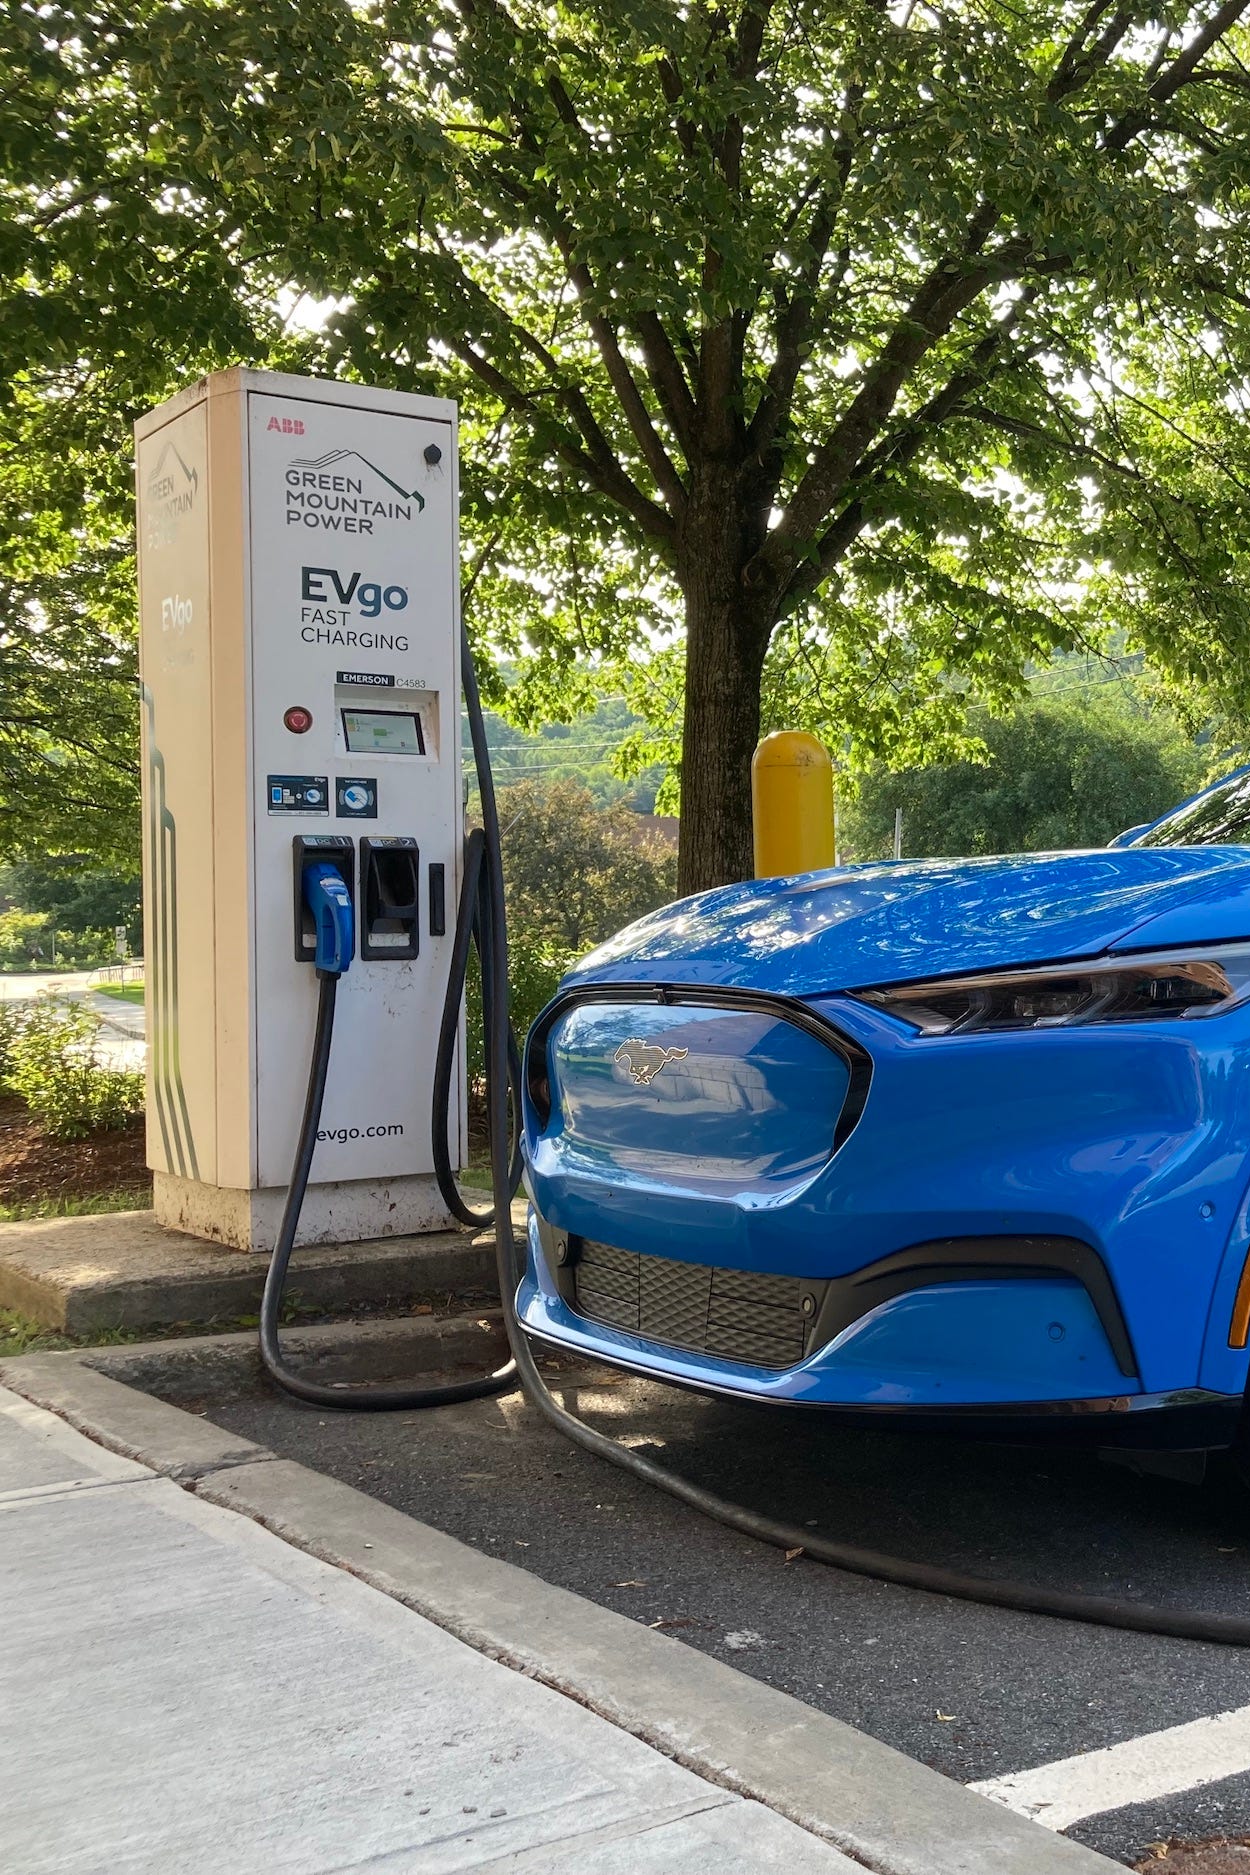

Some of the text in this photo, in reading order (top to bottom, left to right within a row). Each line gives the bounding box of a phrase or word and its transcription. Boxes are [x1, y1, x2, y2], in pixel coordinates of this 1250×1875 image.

[267, 416, 305, 435] ABB
[285, 469, 362, 494] GREEN
[286, 490, 411, 520] MOUNTAIN
[286, 510, 373, 535] POWER
[302, 566, 408, 617] EVgo
[161, 594, 193, 638] EVgo
[301, 607, 351, 626] FAST
[301, 627, 409, 651] CHARGING
[342, 674, 426, 688] EMERSON C4583
[316, 1124, 403, 1143] evgo.com
